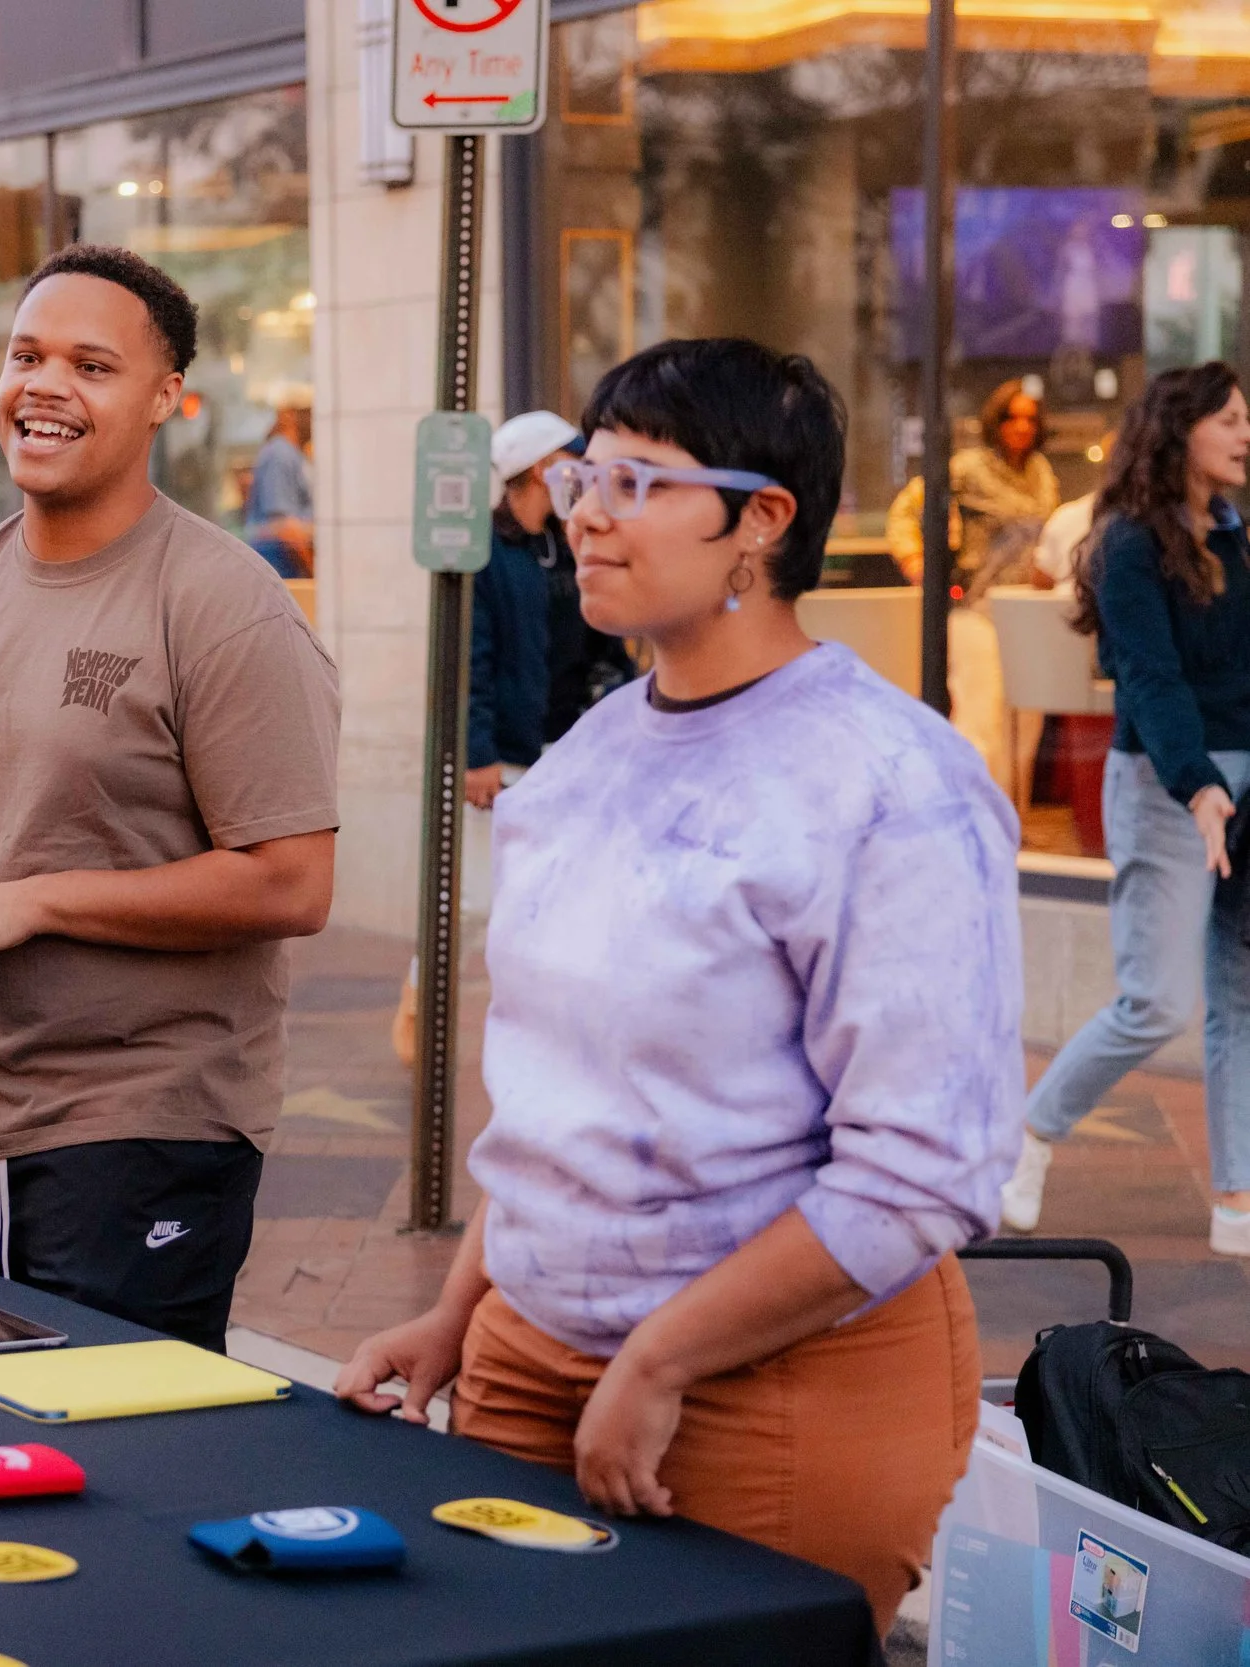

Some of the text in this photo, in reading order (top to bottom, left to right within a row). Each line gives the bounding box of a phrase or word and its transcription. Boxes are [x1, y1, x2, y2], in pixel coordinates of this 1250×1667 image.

[410, 49, 523, 84] Any Time
[63, 647, 144, 688] MEMPHIS
[59, 677, 117, 717] TENN
[152, 1221, 182, 1237] NIKE
